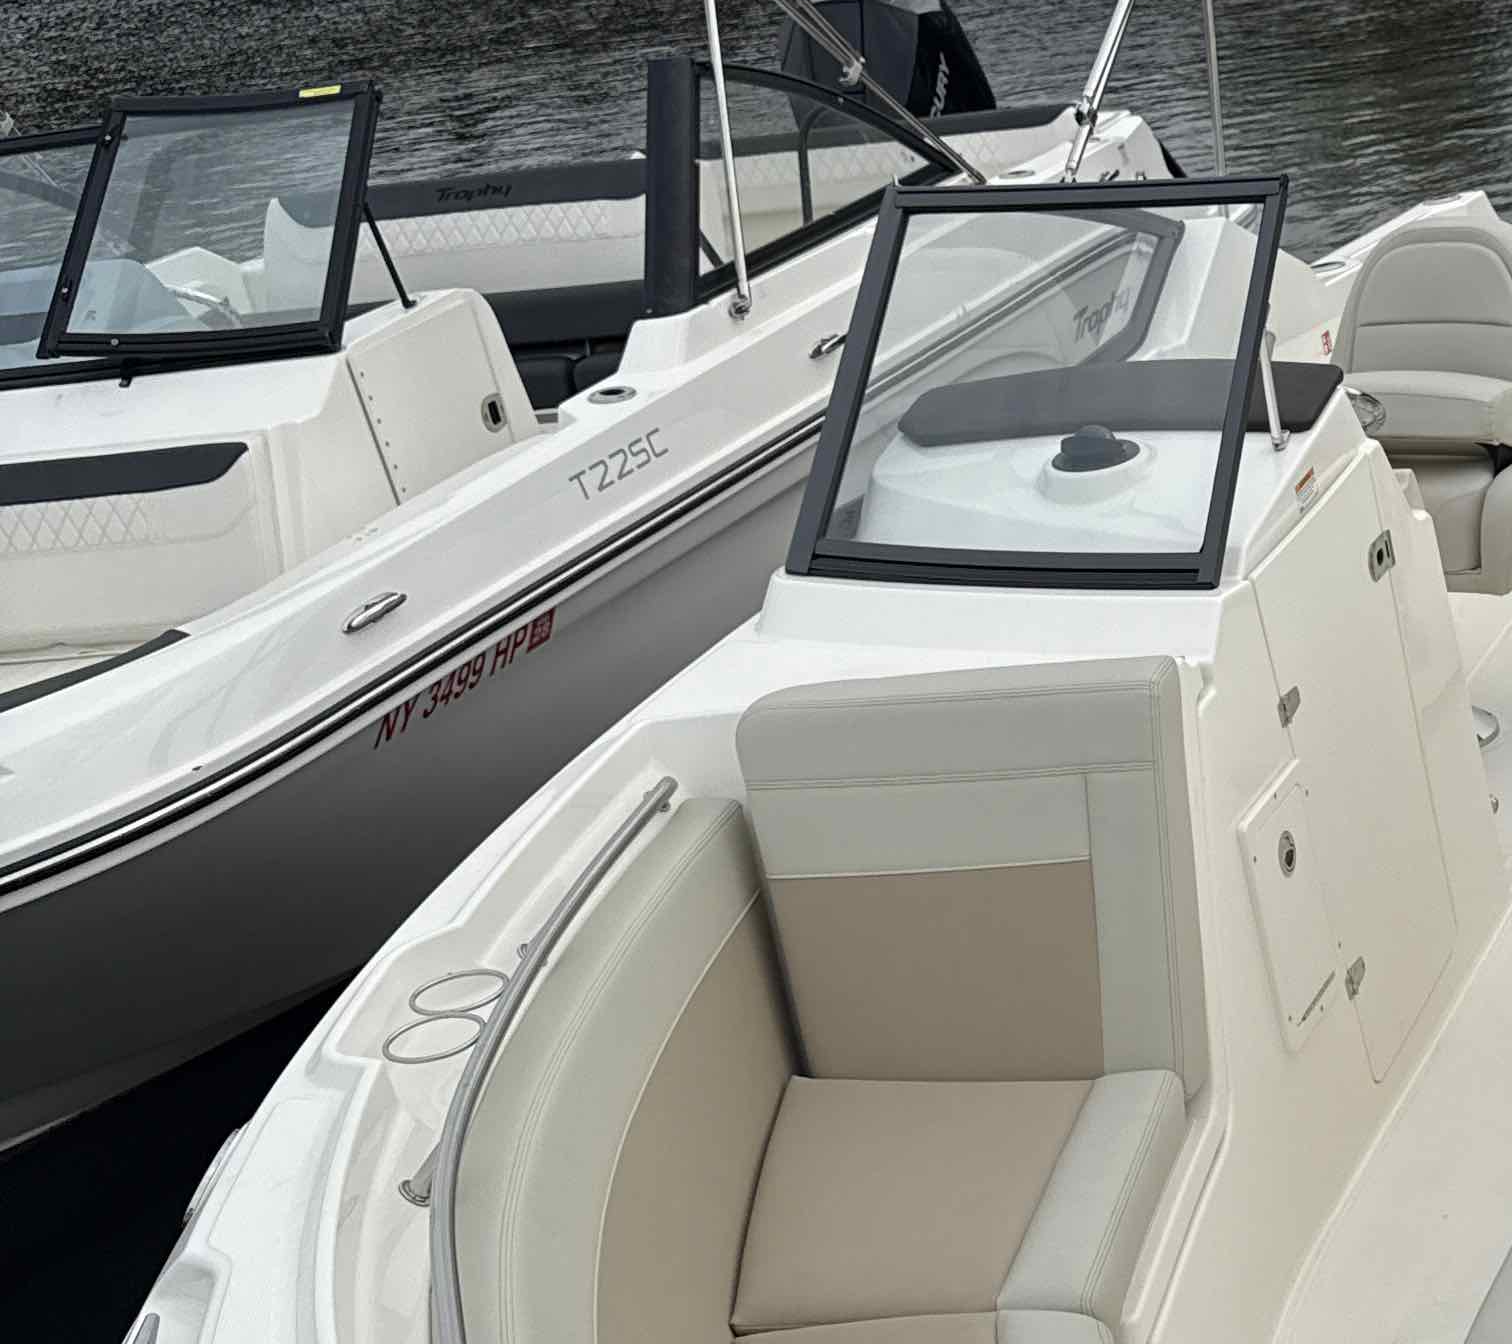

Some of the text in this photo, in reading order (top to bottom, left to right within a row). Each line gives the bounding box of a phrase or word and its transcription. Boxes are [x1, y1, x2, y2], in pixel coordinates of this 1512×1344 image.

[434, 183, 513, 203] Trophy
[373, 694, 420, 750] NY
[422, 652, 486, 719] 3499
[490, 624, 528, 677] HP
